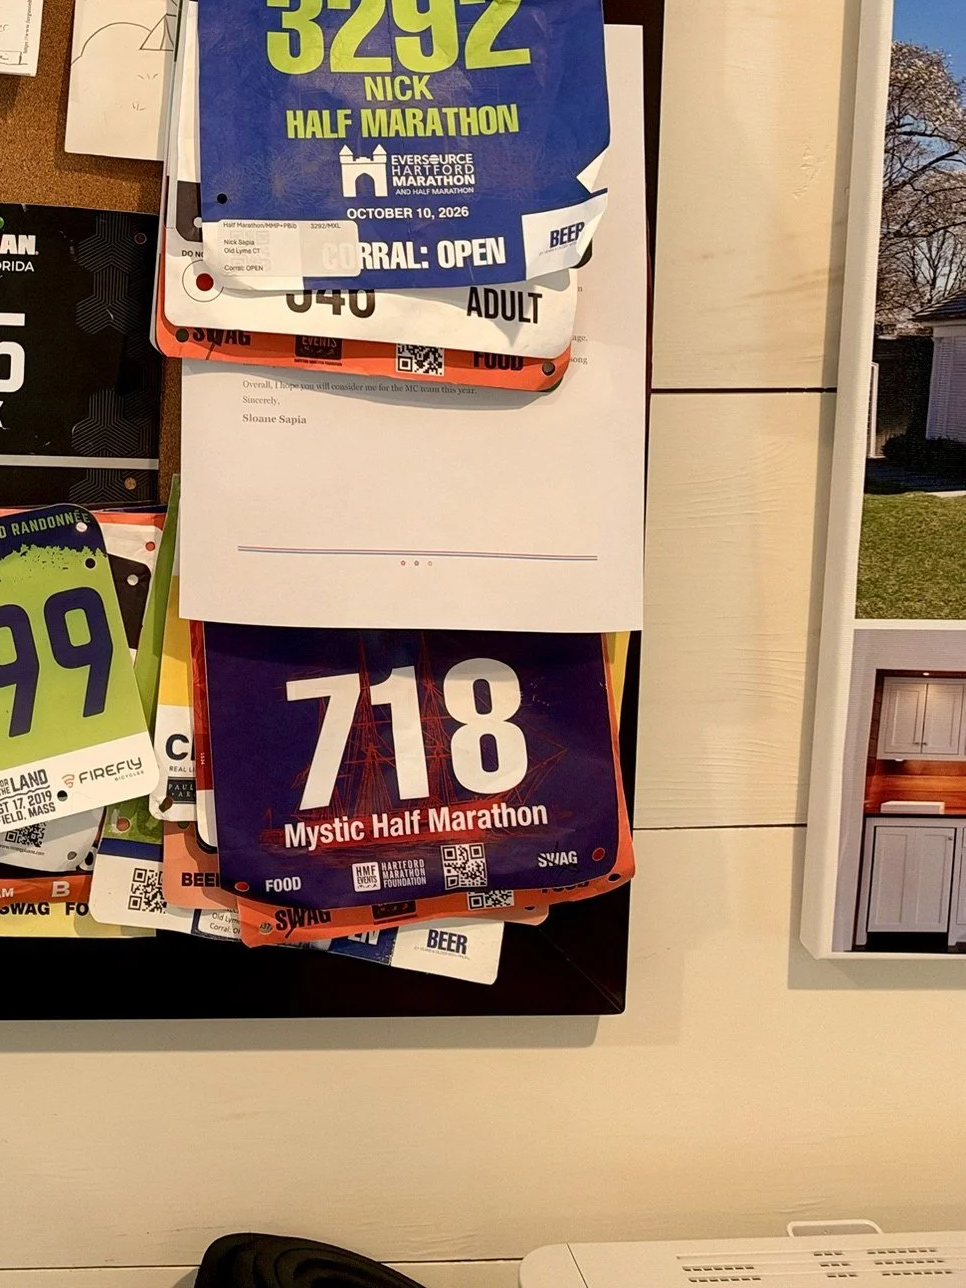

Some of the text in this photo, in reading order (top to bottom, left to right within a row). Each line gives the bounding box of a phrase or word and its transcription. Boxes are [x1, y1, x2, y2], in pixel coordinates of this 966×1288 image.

[364, 75, 433, 102] NICK
[286, 103, 519, 139] HALF MARATHON
[392, 154, 473, 164] EVERSOURCE
[392, 164, 474, 175] HARTFORD
[392, 174, 475, 186] MARATHON
[396, 188, 411, 196] AND
[346, 206, 469, 220] OCTOBER 10, 2026
[437, 237, 506, 266] OPEN
[466, 286, 543, 324] ADULT
[243, 381, 363, 391] Overall, consider
[243, 396, 280, 406] Sincerely,
[242, 414, 307, 425] Sloane Sapia
[286, 658, 529, 812] 718
[78, 757, 143, 784] FIREFLY
[10, 769, 48, 792] LAND
[12, 797, 26, 809] 17,
[28, 790, 52, 806] 2019
[29, 802, 56, 818] MASS
[284, 802, 548, 852] Mystic Half Marathon
[381, 860, 425, 870] HARTFORD
[537, 851, 577, 868] SWAG
[355, 865, 376, 877] HMF
[383, 868, 426, 879] MARATHON
[265, 876, 301, 892] FOOD
[357, 875, 377, 884] EVENTS
[384, 877, 427, 888] FOUNDATION
[52, 881, 71, 898] B
[426, 929, 468, 955] BEER
